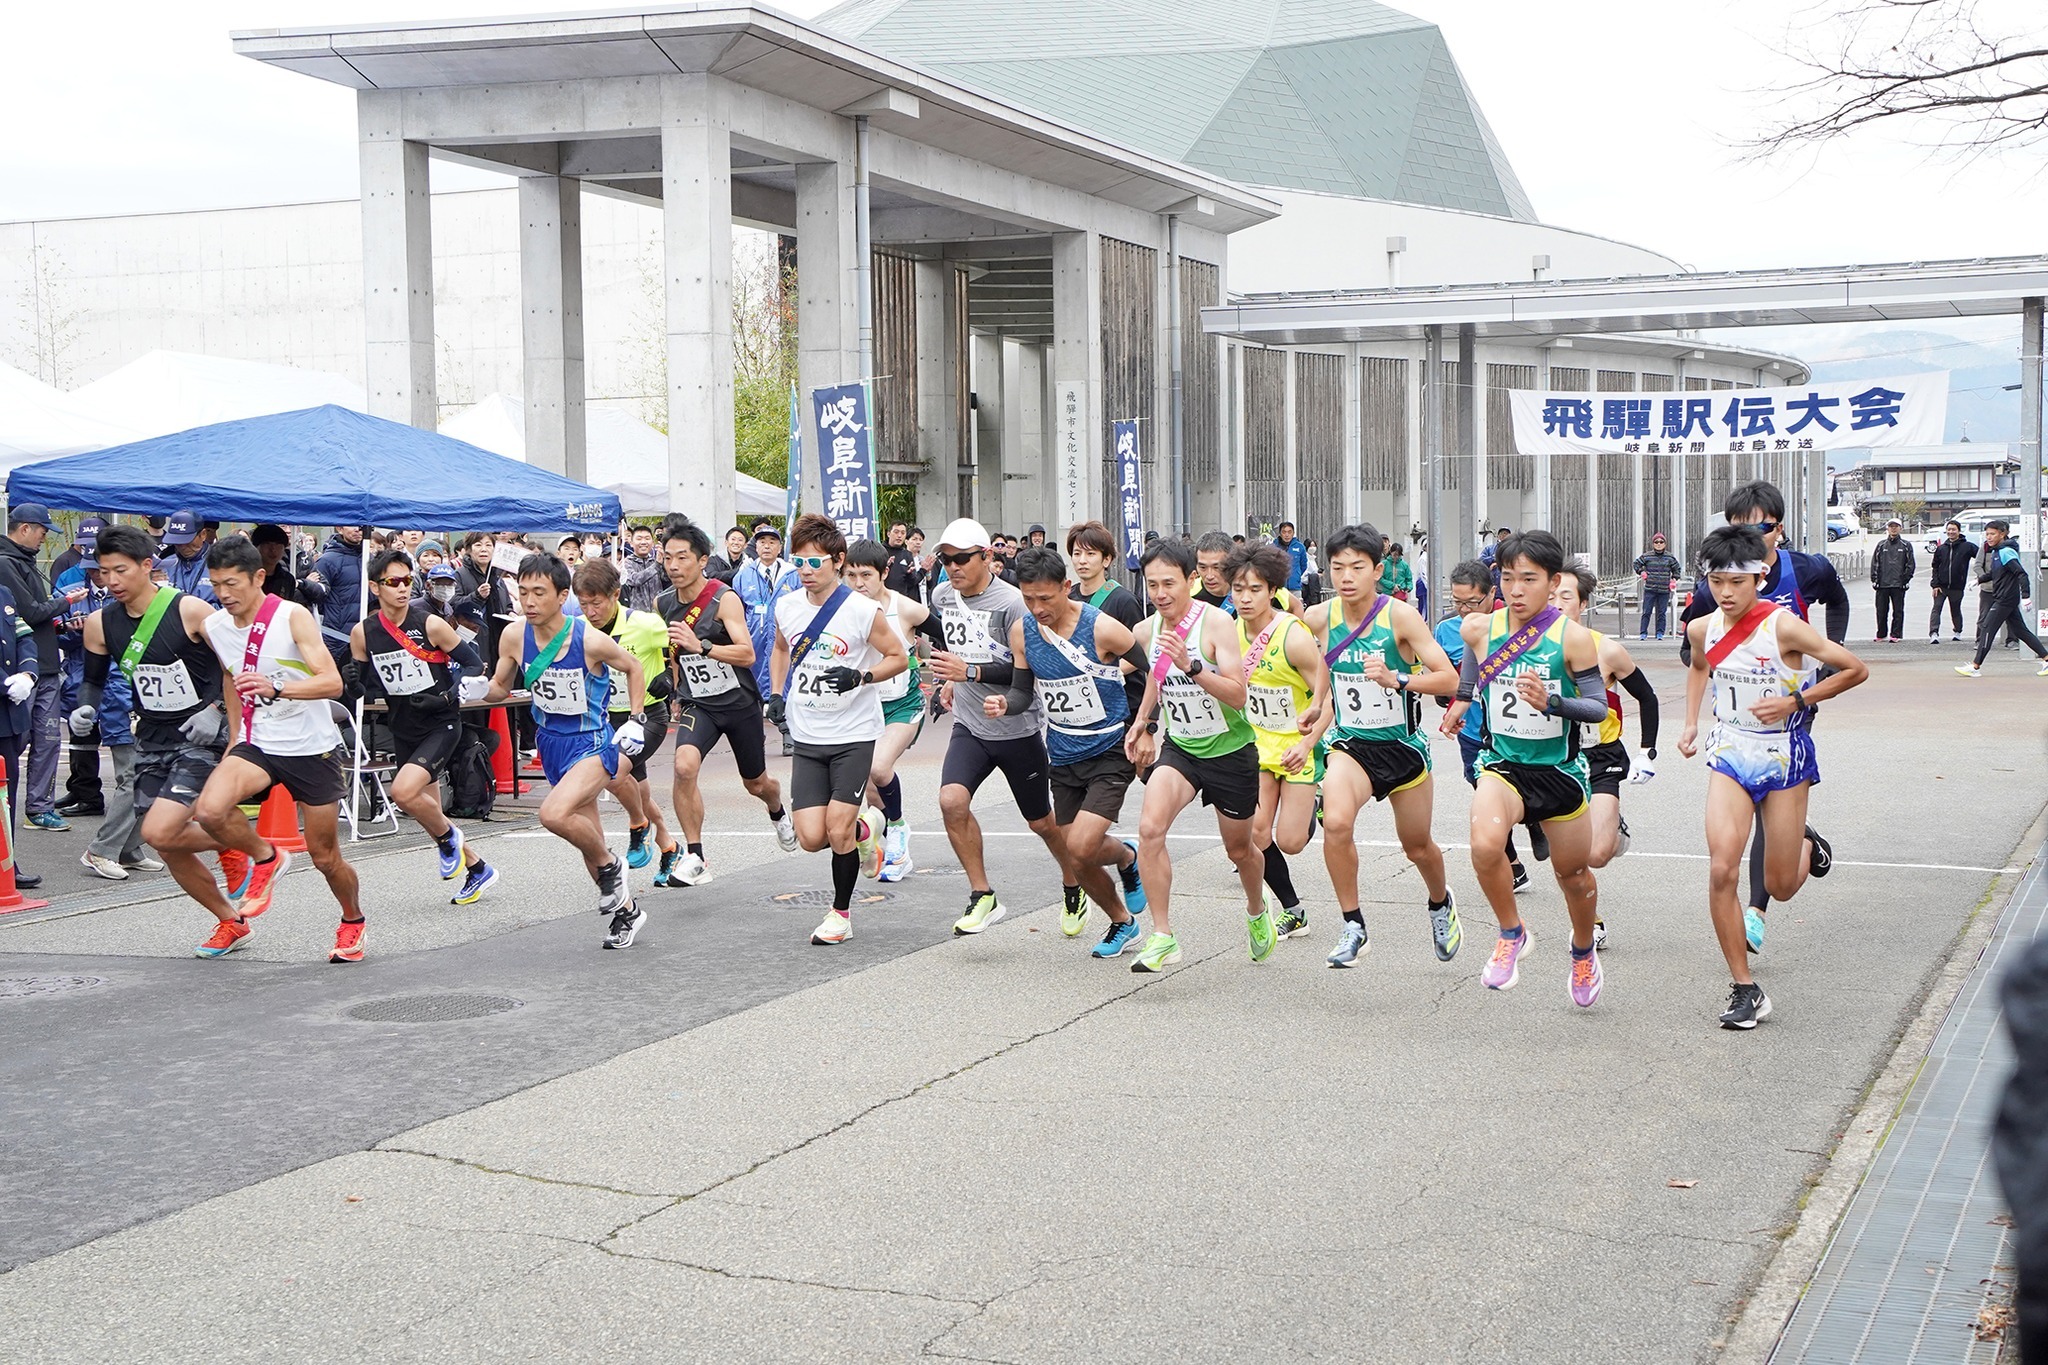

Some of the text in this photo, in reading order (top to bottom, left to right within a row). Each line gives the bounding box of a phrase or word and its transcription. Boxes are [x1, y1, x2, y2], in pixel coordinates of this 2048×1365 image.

[1624, 438, 1815, 454] 岐阜新聞 岐阜放送
[820, 394, 869, 548] 岐阜新聞
[1117, 429, 1142, 560] 岐阜新聞
[579, 503, 603, 518] LOGOS
[1257, 659, 1273, 672] PS
[798, 672, 842, 697] 24-
